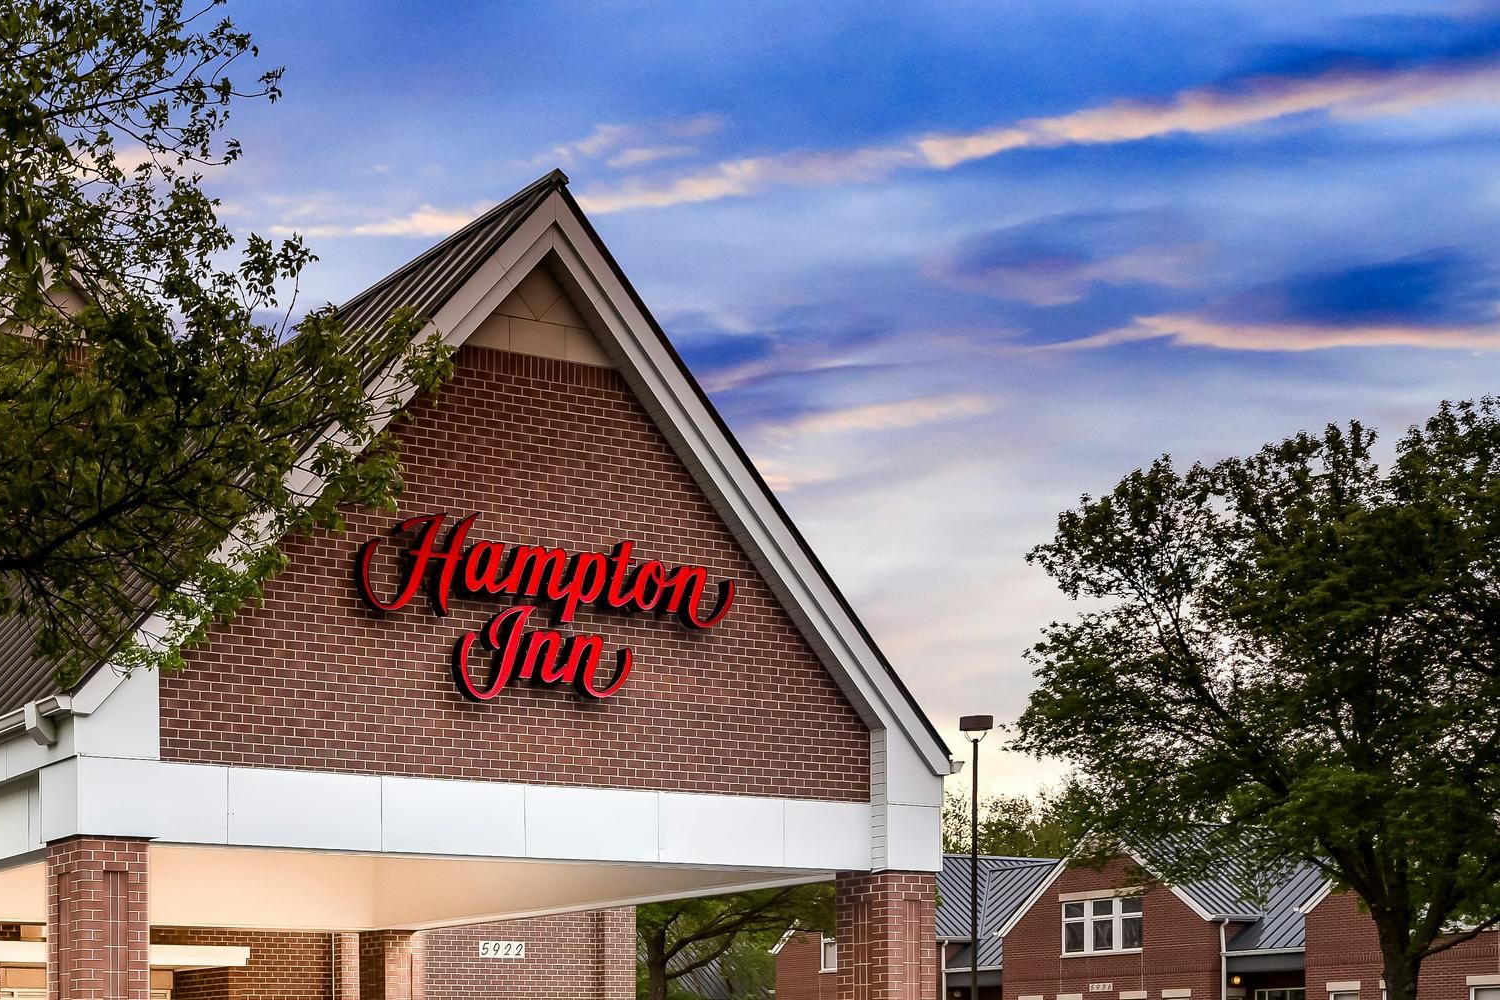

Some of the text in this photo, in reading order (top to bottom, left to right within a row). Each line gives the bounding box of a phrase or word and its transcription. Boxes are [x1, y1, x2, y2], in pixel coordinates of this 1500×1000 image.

[355, 511, 735, 629] Hampton
[451, 605, 632, 699] Inn
[481, 942, 523, 956] 5922
